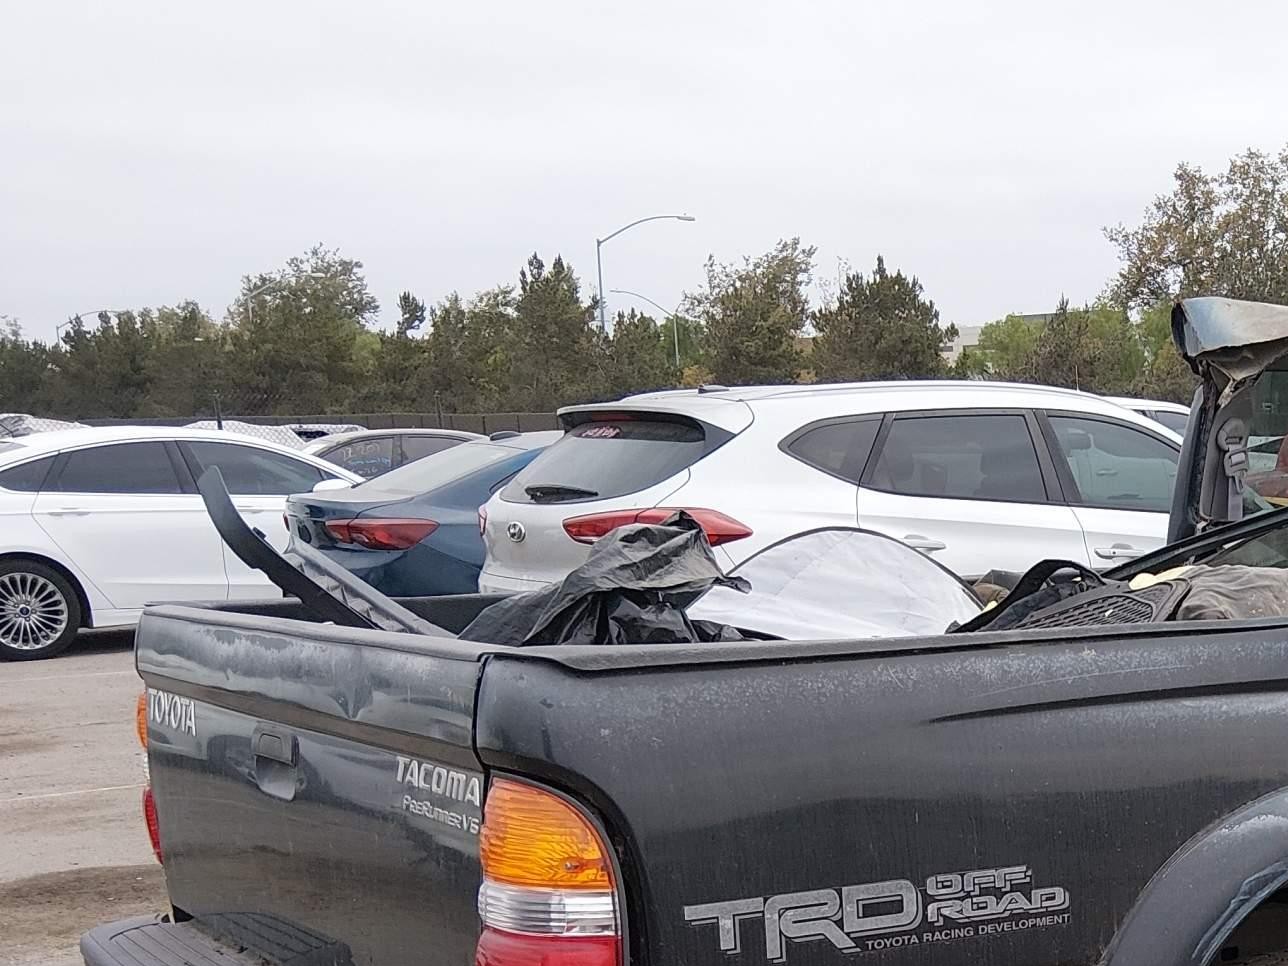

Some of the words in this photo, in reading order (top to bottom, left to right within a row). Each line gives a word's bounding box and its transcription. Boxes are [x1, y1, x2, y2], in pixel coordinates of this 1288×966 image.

[149, 688, 197, 737] TOYOTA
[397, 756, 480, 807] TACOMA
[926, 865, 1032, 899] OFF
[684, 879, 923, 964] TRD
[927, 886, 1071, 926] ROAD
[866, 933, 919, 951] TOYOTA
[923, 926, 974, 943] RACING
[978, 912, 1072, 936] DEVELOPMENT
